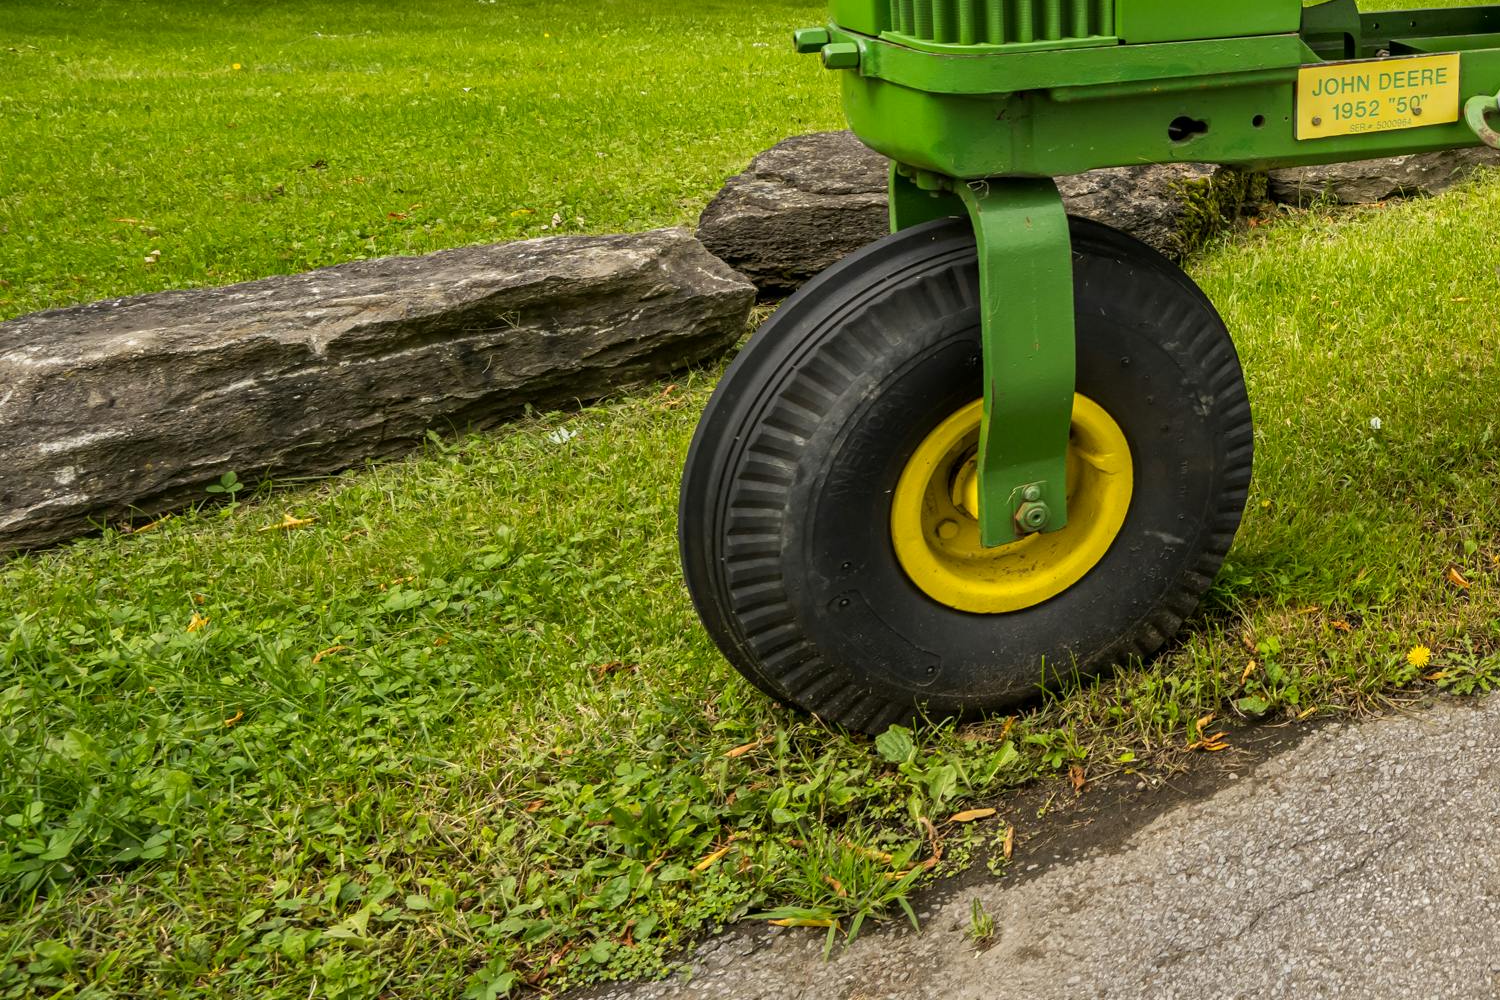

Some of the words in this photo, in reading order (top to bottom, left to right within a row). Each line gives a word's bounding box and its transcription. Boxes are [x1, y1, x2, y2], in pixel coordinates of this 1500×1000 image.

[1312, 74, 1370, 97] JOHN
[1379, 67, 1448, 90] DEERE
[1332, 99, 1380, 120] 1952
